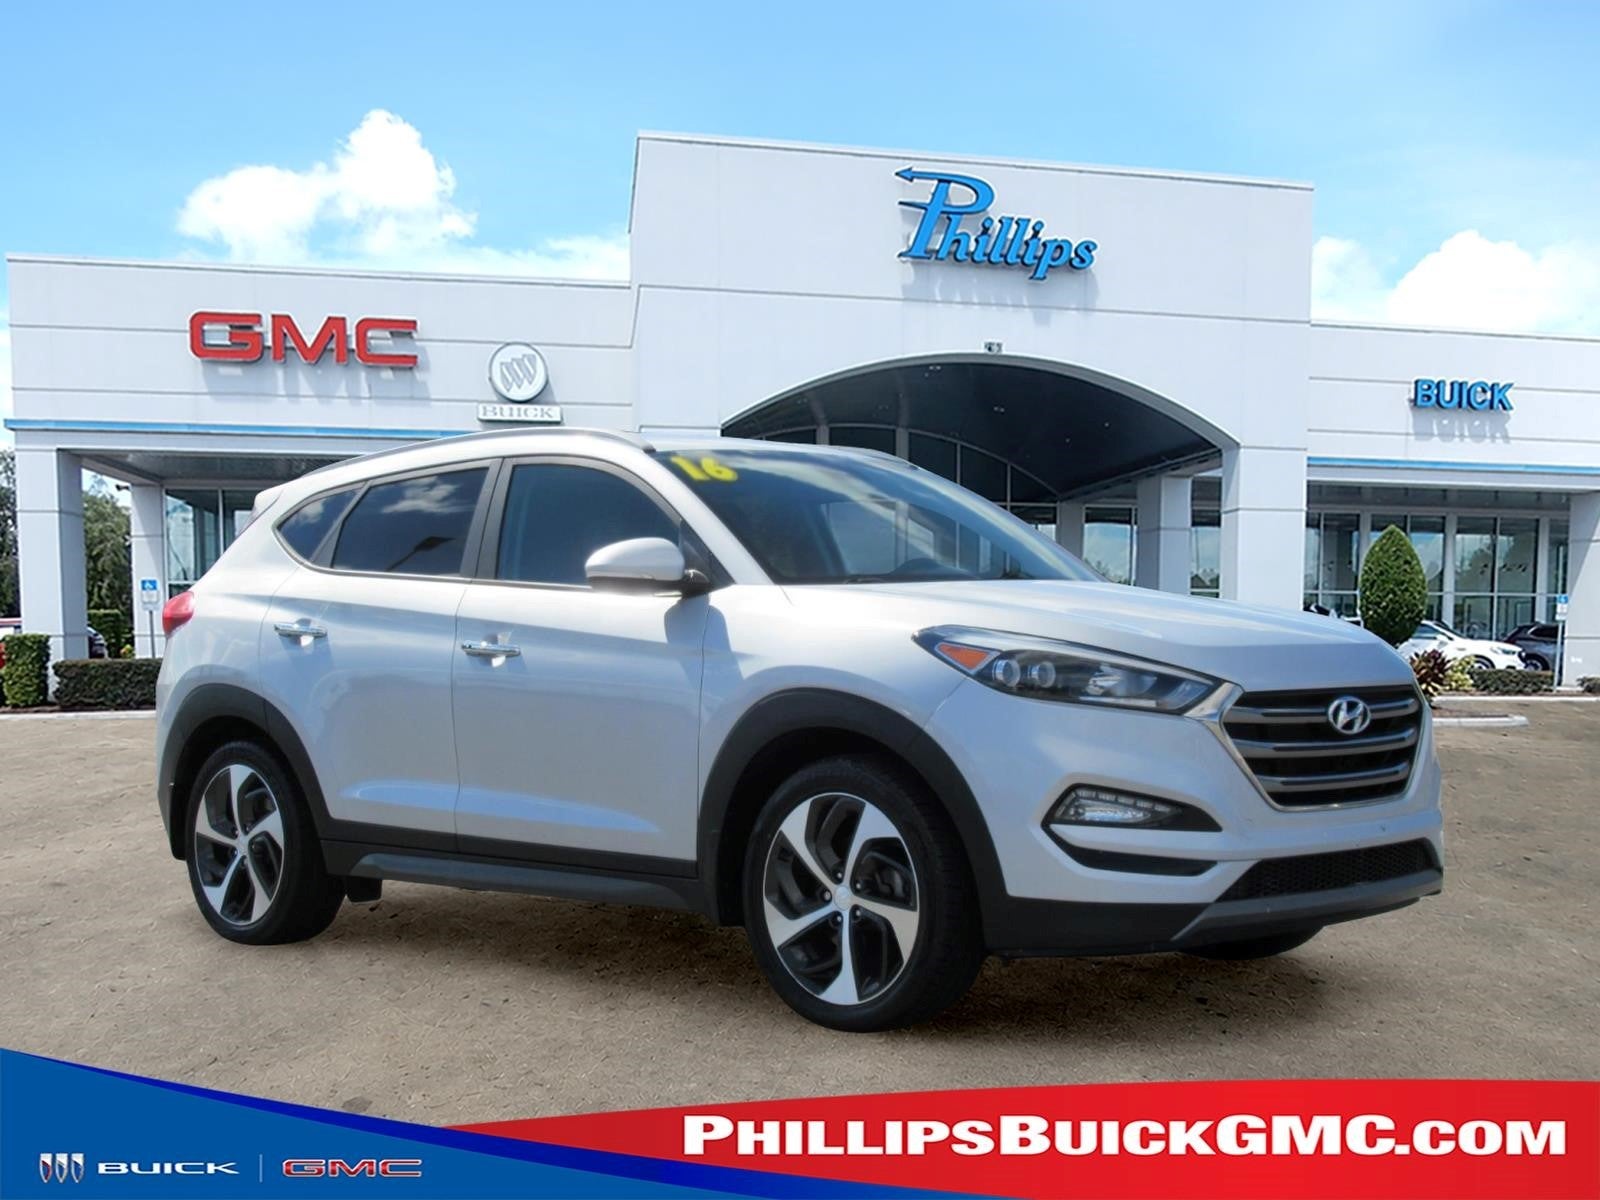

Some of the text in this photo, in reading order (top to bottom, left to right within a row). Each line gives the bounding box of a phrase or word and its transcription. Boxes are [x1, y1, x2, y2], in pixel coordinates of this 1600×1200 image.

[895, 167, 1098, 281] Phillips
[189, 310, 418, 368] GMC
[1414, 378, 1514, 411] BUICK
[482, 405, 553, 419] BUICK
[670, 455, 738, 481] 16
